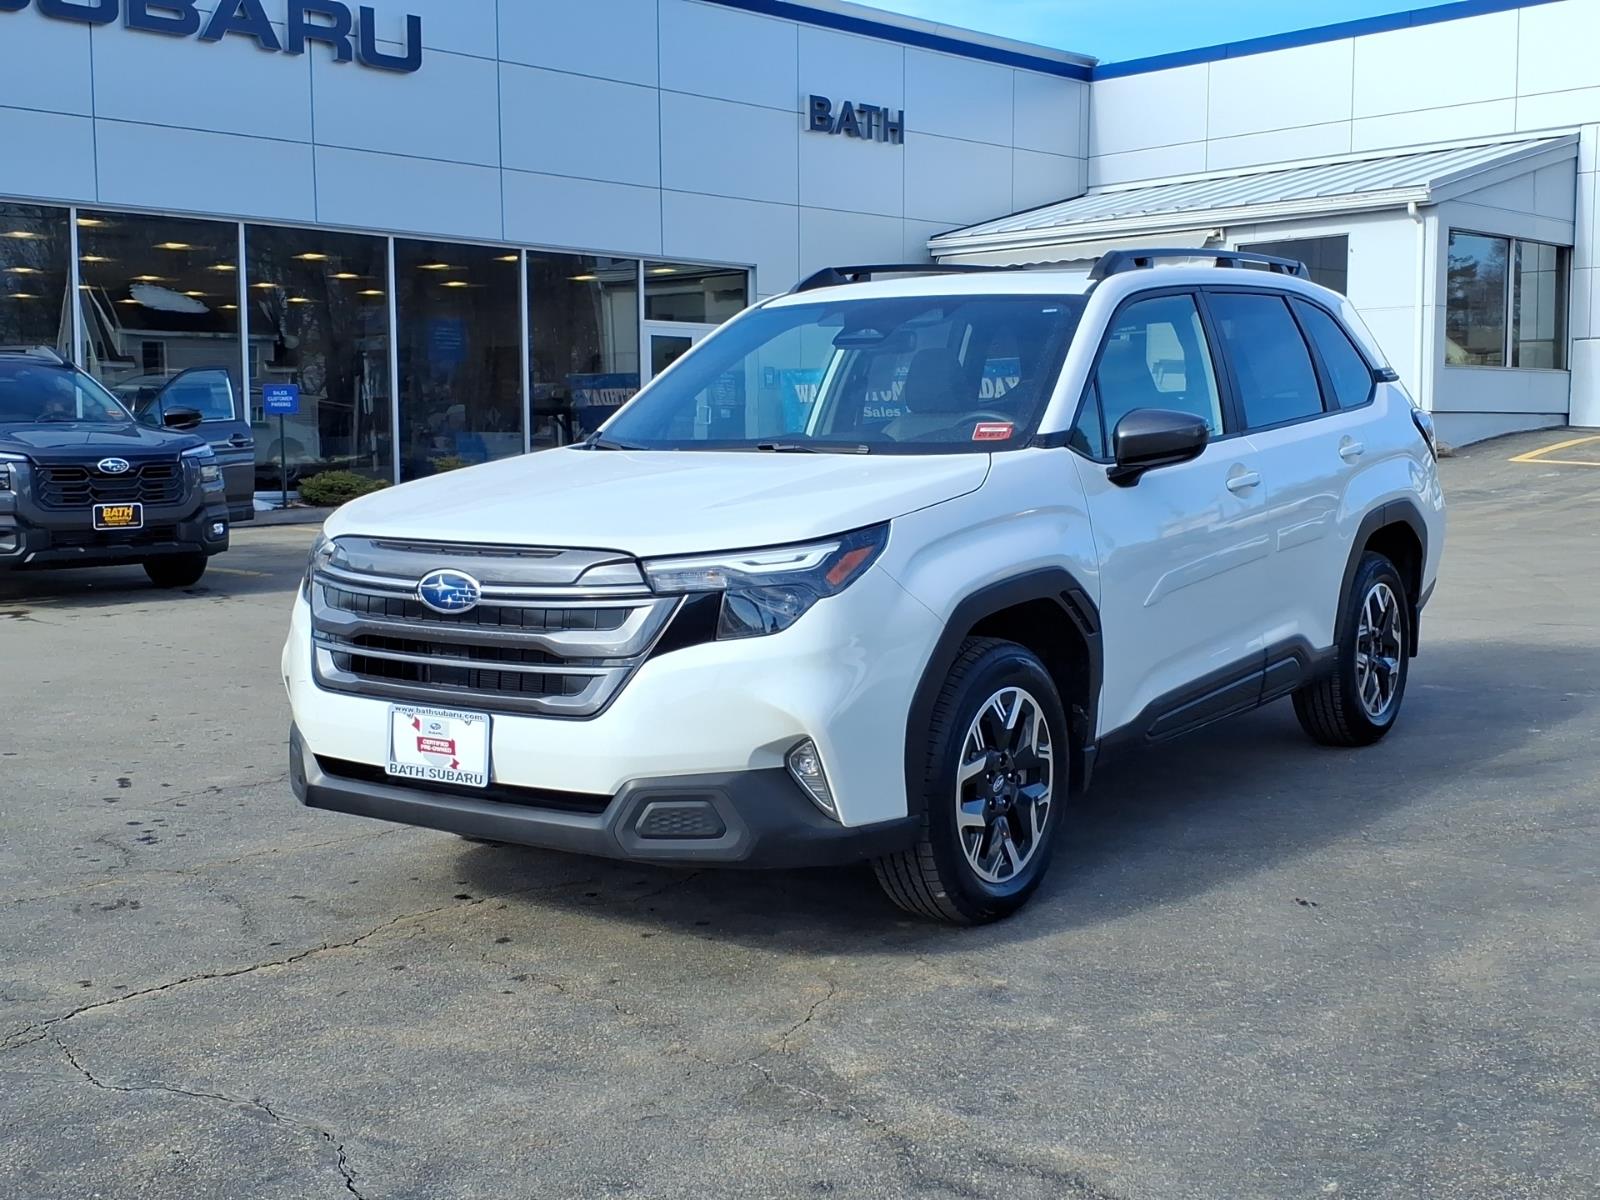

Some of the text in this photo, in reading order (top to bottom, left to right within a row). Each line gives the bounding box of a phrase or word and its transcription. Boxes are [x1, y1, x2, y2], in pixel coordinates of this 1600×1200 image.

[808, 94, 904, 145] BATH
[863, 406, 901, 418] Sales
[103, 507, 133, 517] BATH
[394, 705, 483, 721] www.bathsubaru.com
[420, 744, 453, 754] PRE-OWNED
[422, 739, 450, 748] CERTIFIED
[389, 763, 483, 785] BATH SUBARU
